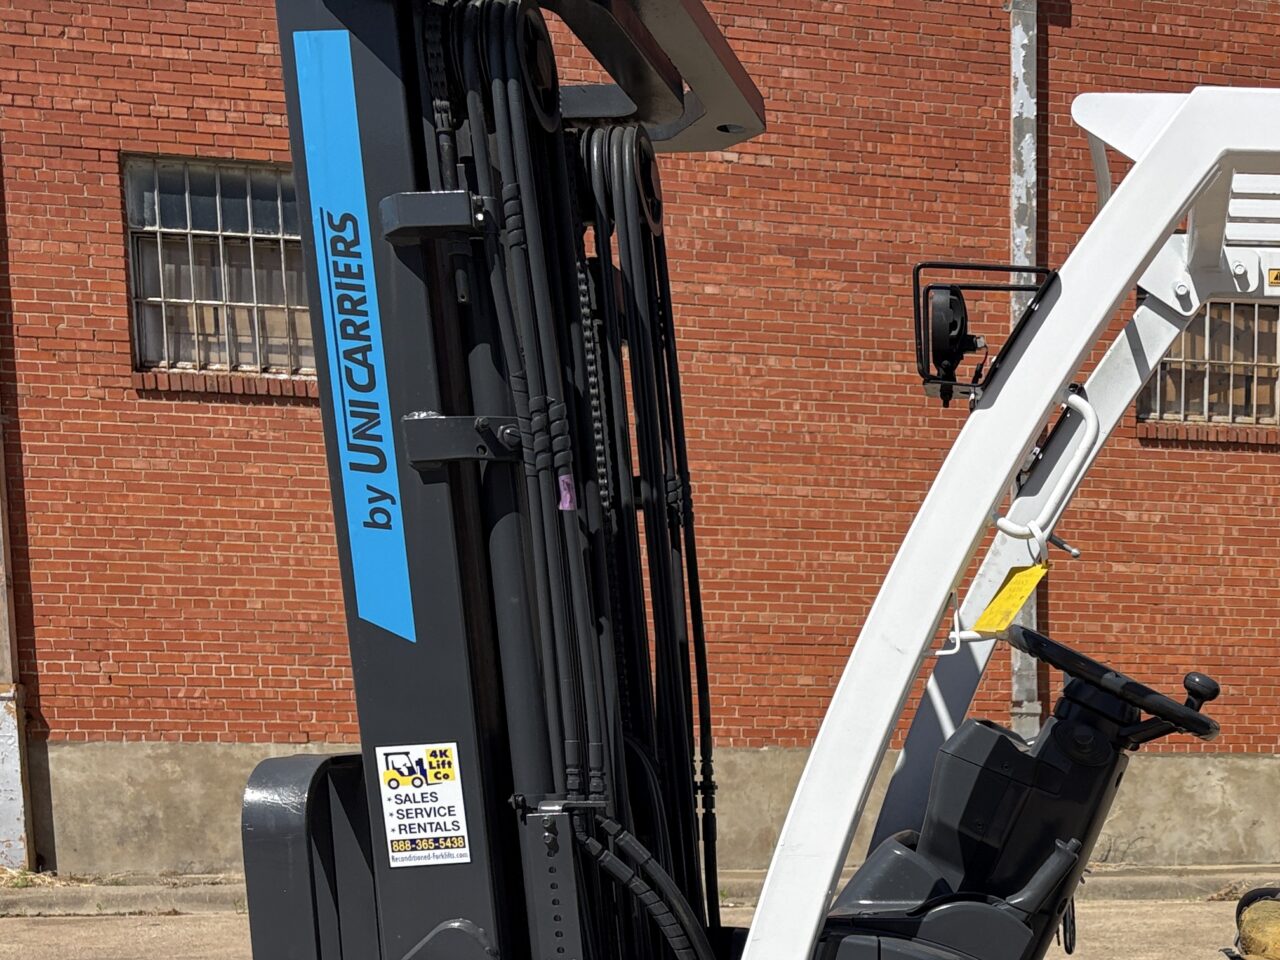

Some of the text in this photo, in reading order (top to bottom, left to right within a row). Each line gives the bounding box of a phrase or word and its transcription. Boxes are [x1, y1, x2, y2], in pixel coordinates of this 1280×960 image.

[363, 484, 396, 530] by
[430, 750, 449, 759] 4K
[429, 760, 452, 769] Lift
[434, 771, 450, 780] Co
[394, 792, 438, 805] SALES
[396, 806, 456, 820] SERVICE
[398, 821, 461, 835] RENTALS
[392, 838, 464, 851] 888-365-5438
